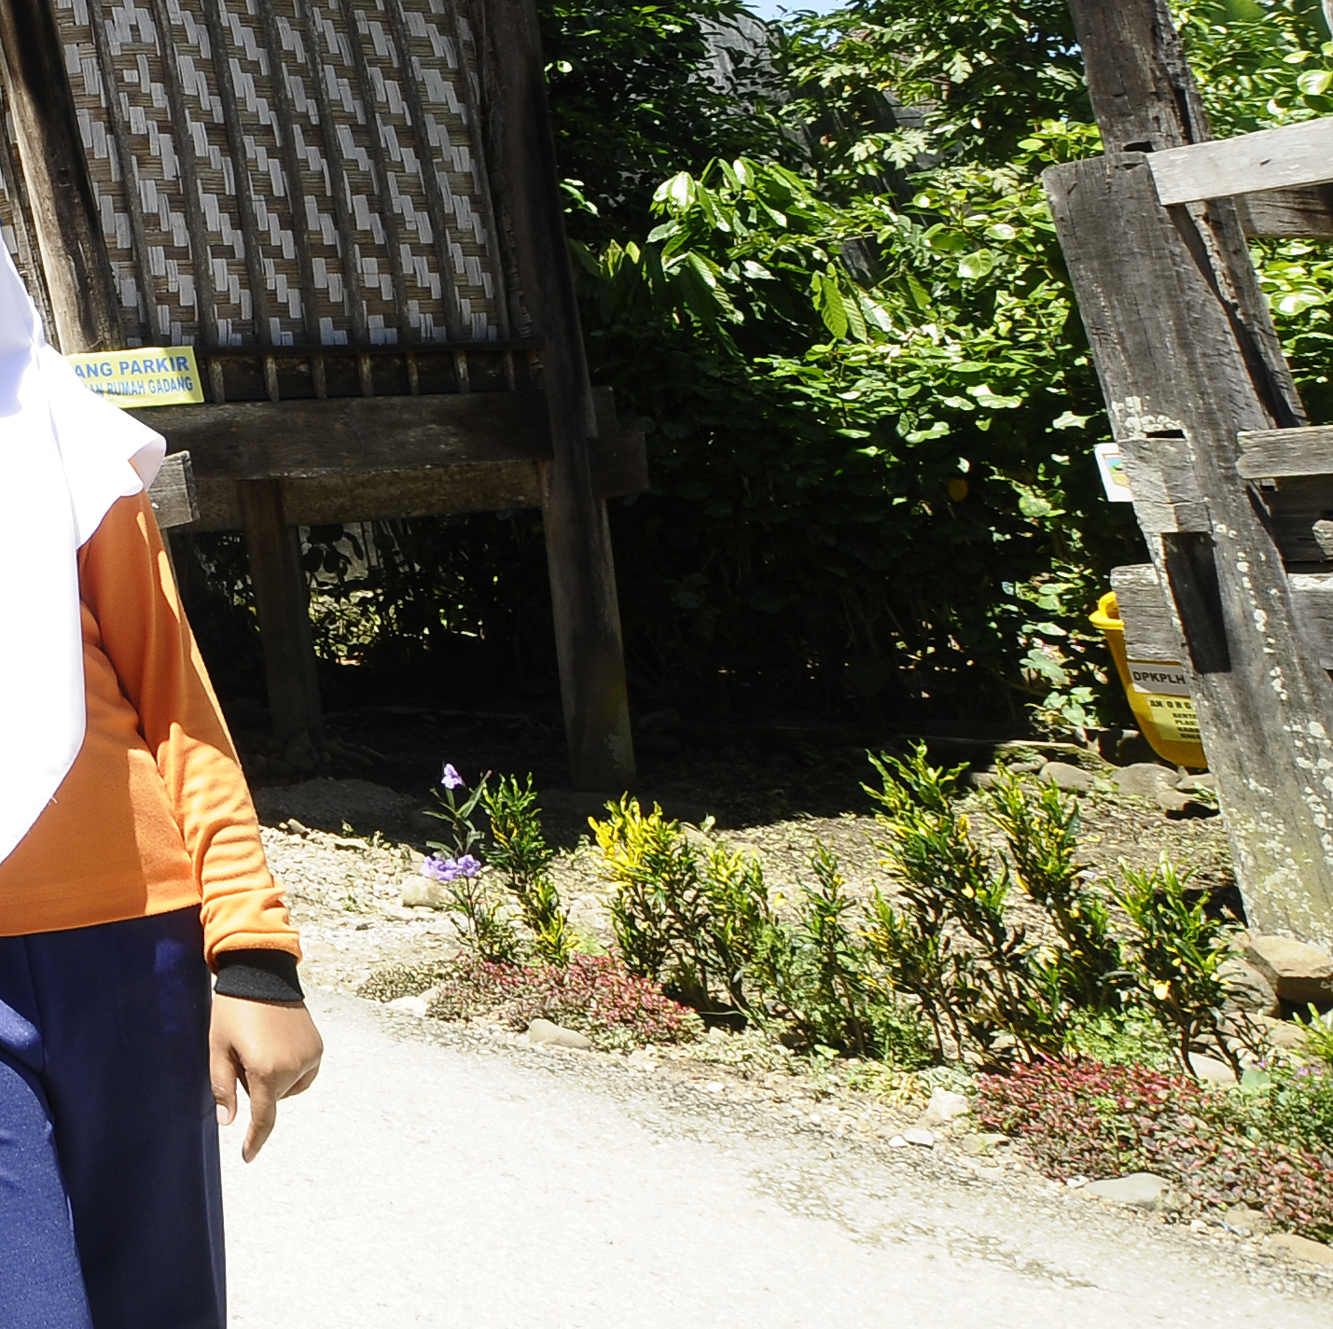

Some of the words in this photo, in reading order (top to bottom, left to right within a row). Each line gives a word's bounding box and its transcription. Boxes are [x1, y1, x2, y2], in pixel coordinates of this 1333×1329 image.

[75, 362, 113, 378] ANG
[119, 356, 190, 376] PARKIR
[107, 380, 146, 395] RUMAH
[148, 376, 193, 394] GADANG
